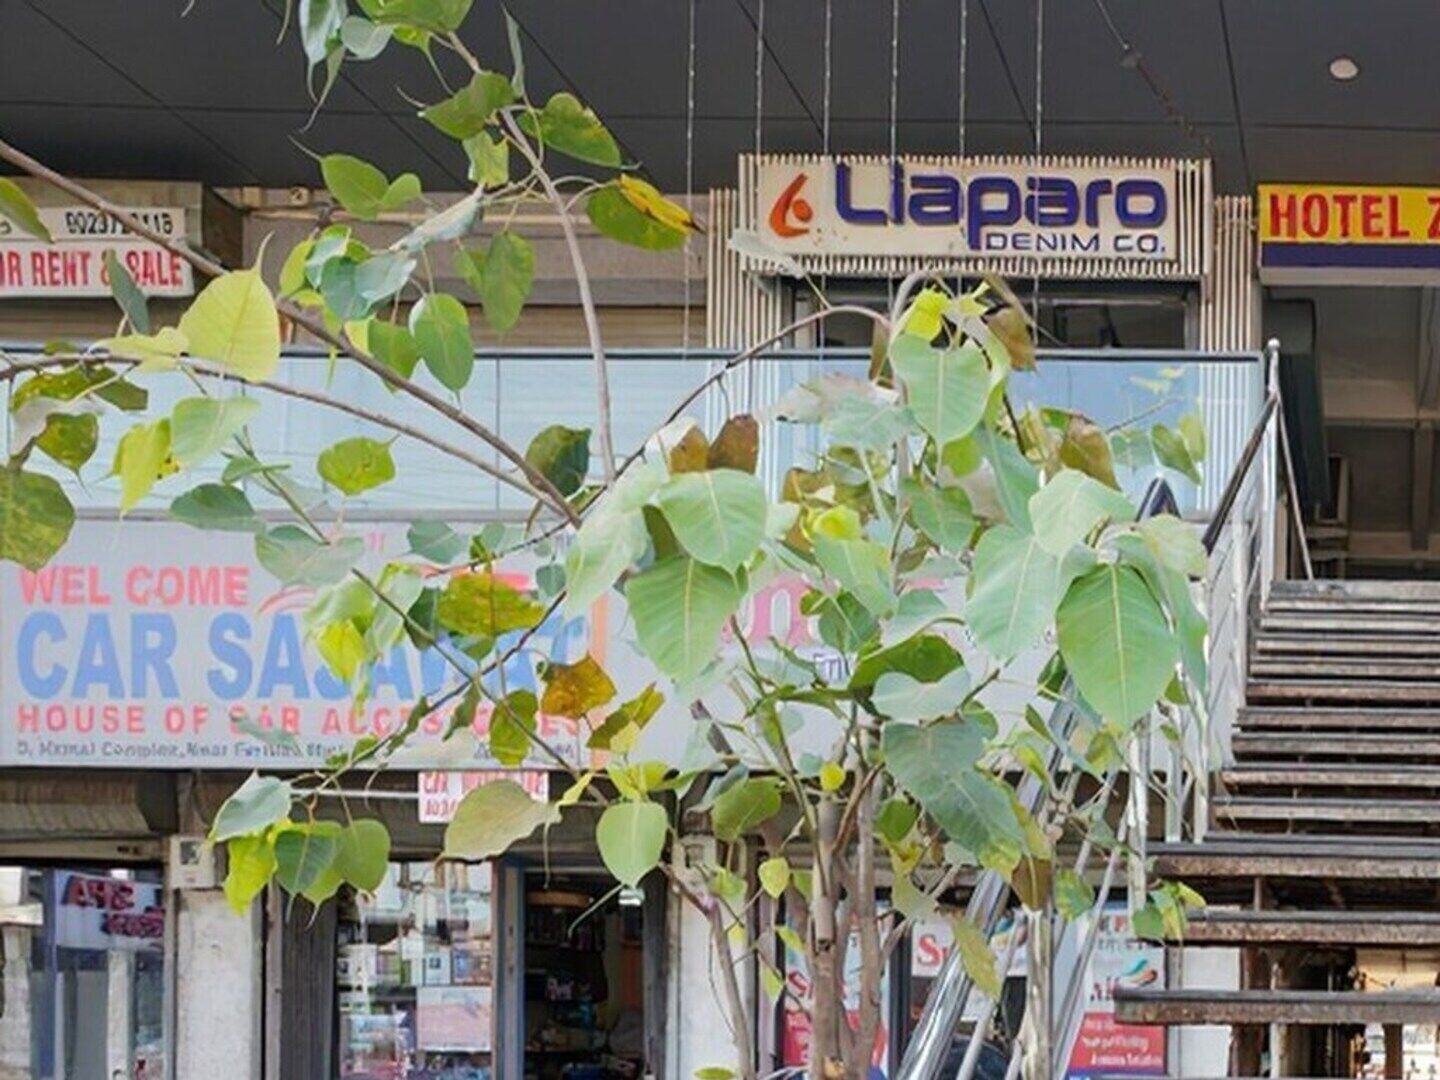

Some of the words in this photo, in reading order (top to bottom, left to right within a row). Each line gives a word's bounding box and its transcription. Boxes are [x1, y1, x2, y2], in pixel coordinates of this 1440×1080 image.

[1269, 193, 1410, 239] HOTEL
[985, 232, 1101, 251] DENIM
[1113, 234, 1166, 254] CO.
[31, 250, 91, 287] RENT
[125, 250, 184, 287] SALE
[19, 566, 111, 606] WEL
[125, 565, 251, 606] COME
[16, 610, 181, 701] CAR
[16, 704, 146, 735] HOUSE
[164, 704, 211, 735] OF
